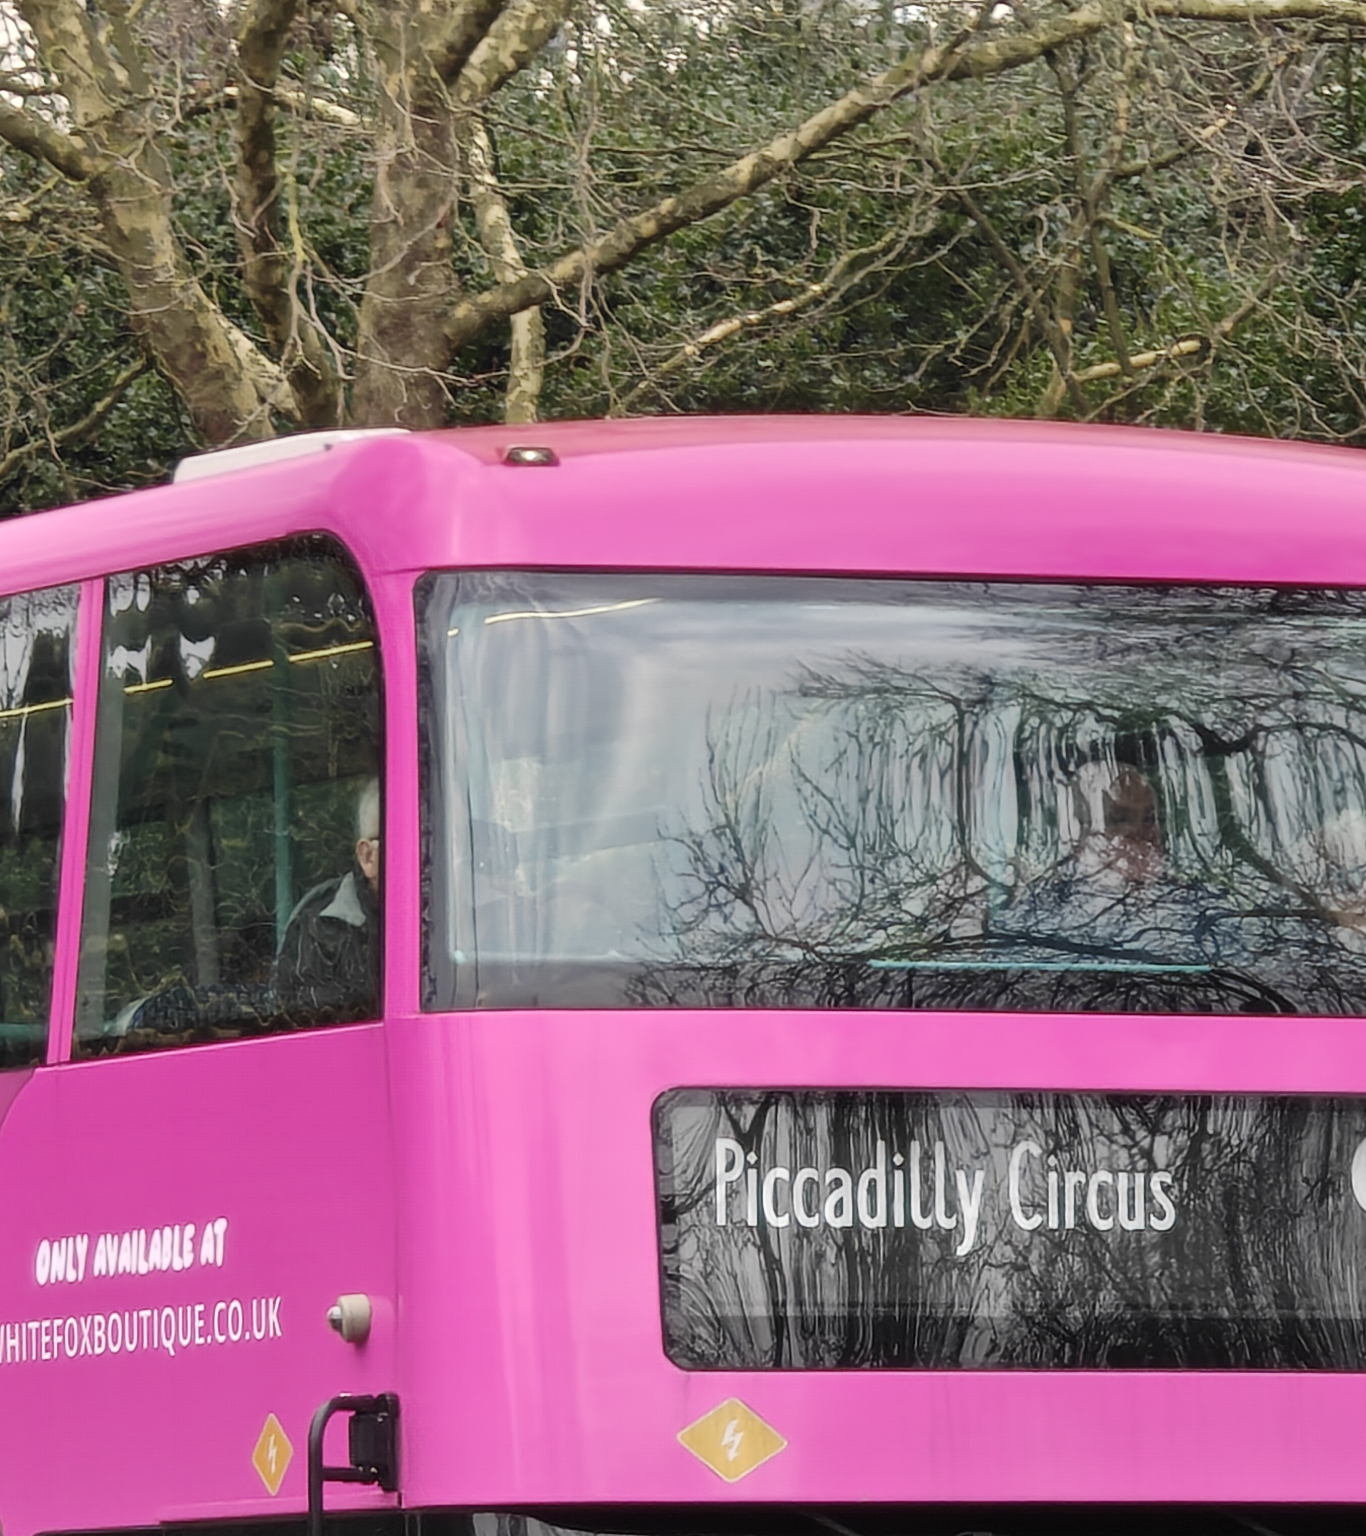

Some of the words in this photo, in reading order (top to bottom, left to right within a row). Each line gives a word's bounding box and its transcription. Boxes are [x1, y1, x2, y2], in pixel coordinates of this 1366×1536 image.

[715, 1137, 985, 1256] Piccadilly
[1008, 1140, 1176, 1232] Circus
[34, 1233, 90, 1286] ONLY
[92, 1221, 196, 1278] AVAILABLE
[199, 1217, 229, 1267] AT
